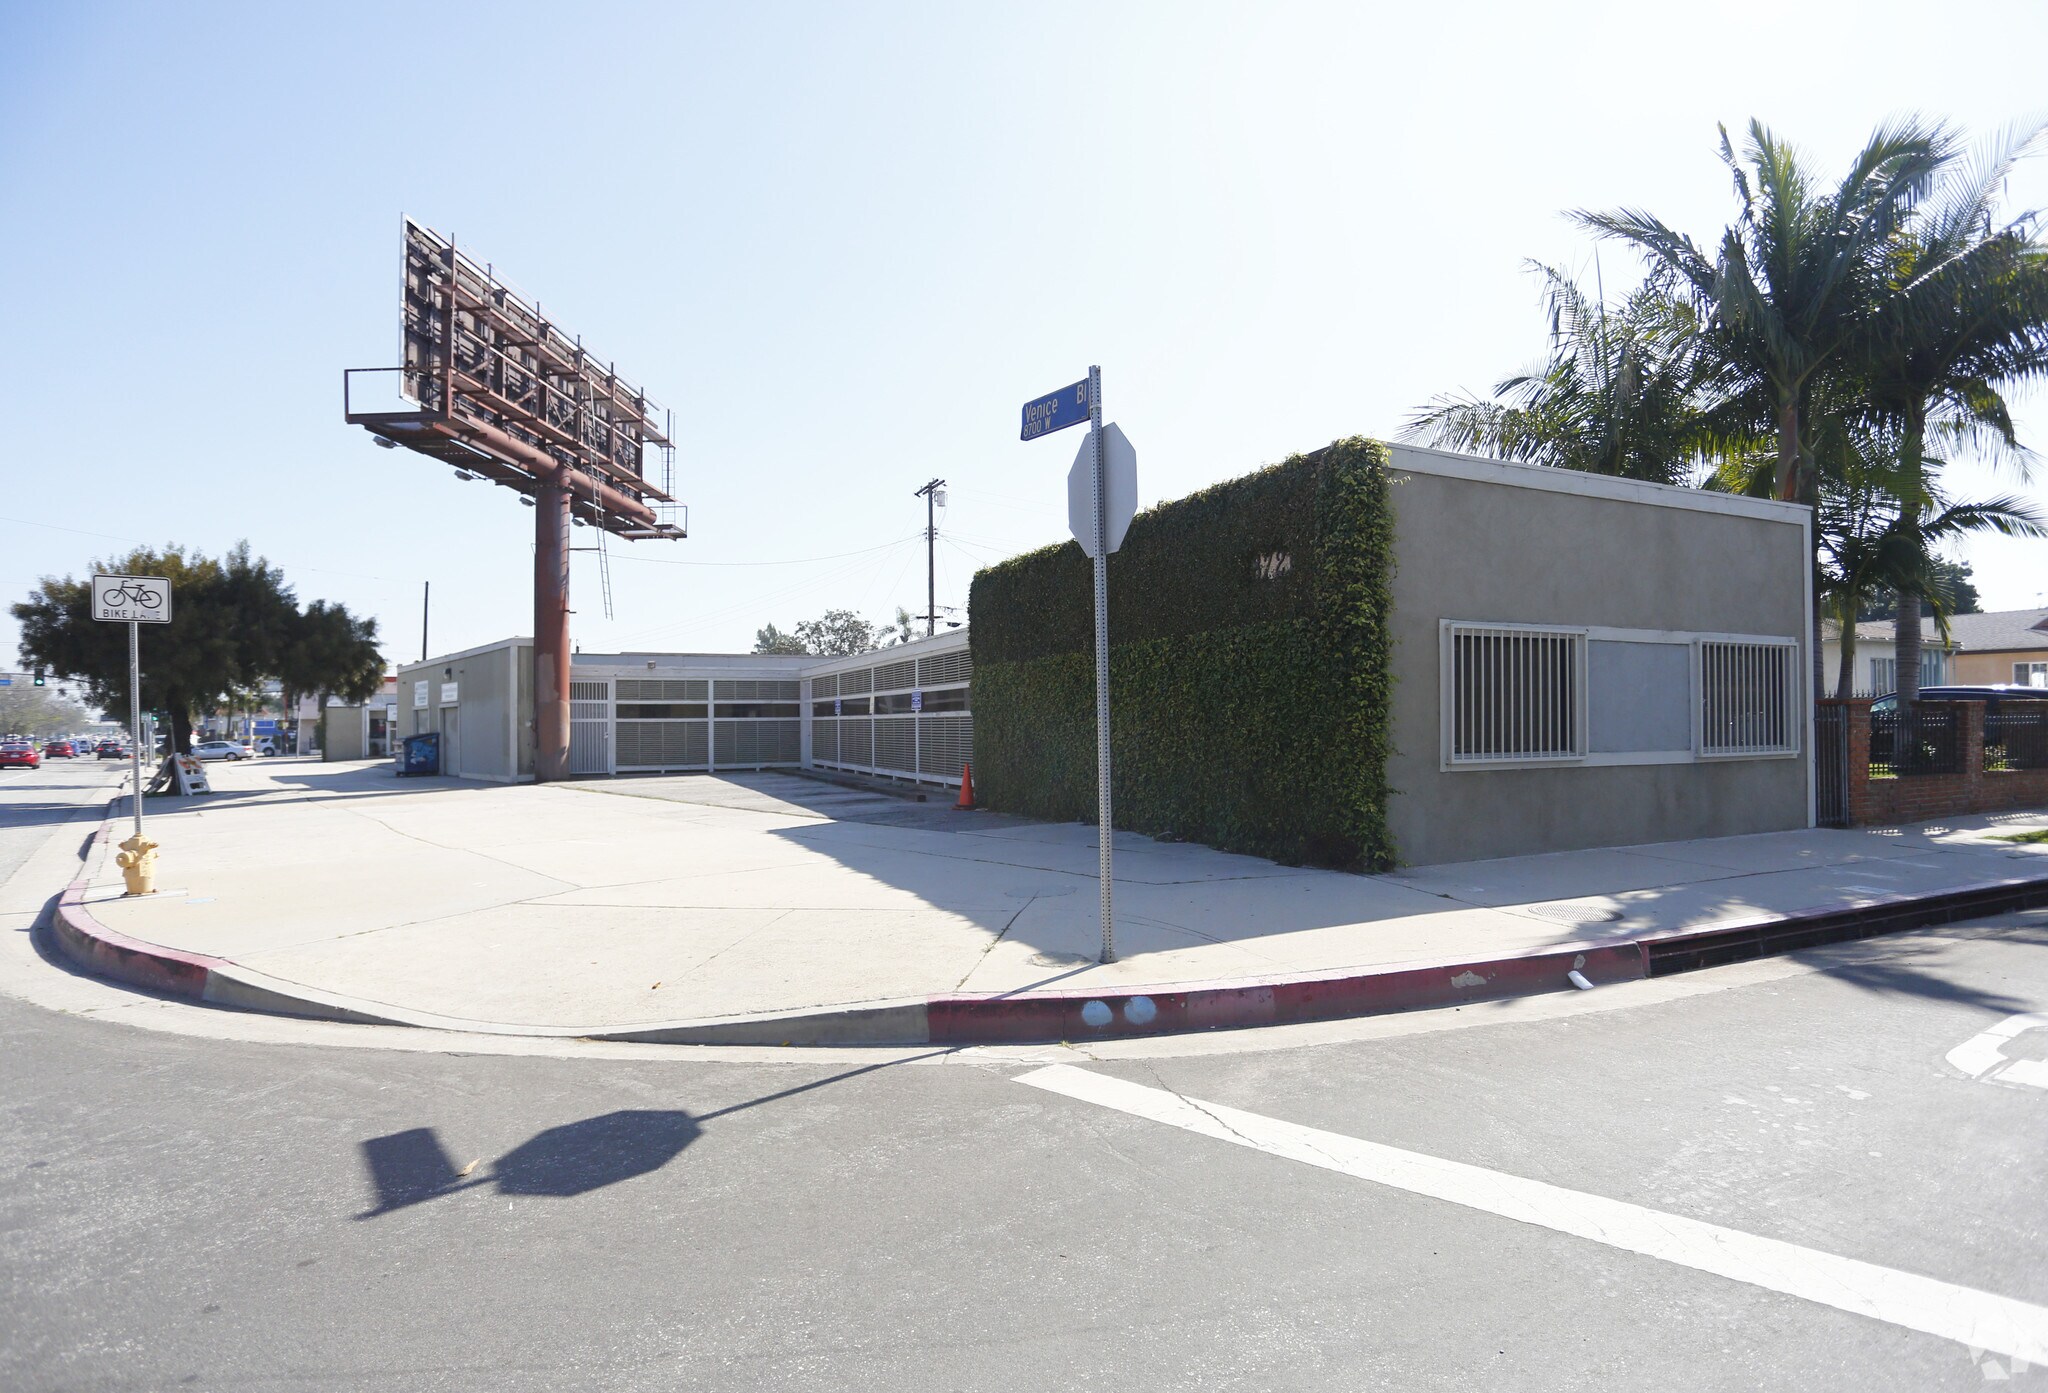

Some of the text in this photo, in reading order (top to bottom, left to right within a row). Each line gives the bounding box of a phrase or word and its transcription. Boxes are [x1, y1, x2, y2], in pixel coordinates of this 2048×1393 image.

[1025, 383, 1087, 423] Venice Bl
[1023, 416, 1051, 437] 8700 W
[103, 609, 127, 618] BIKE
